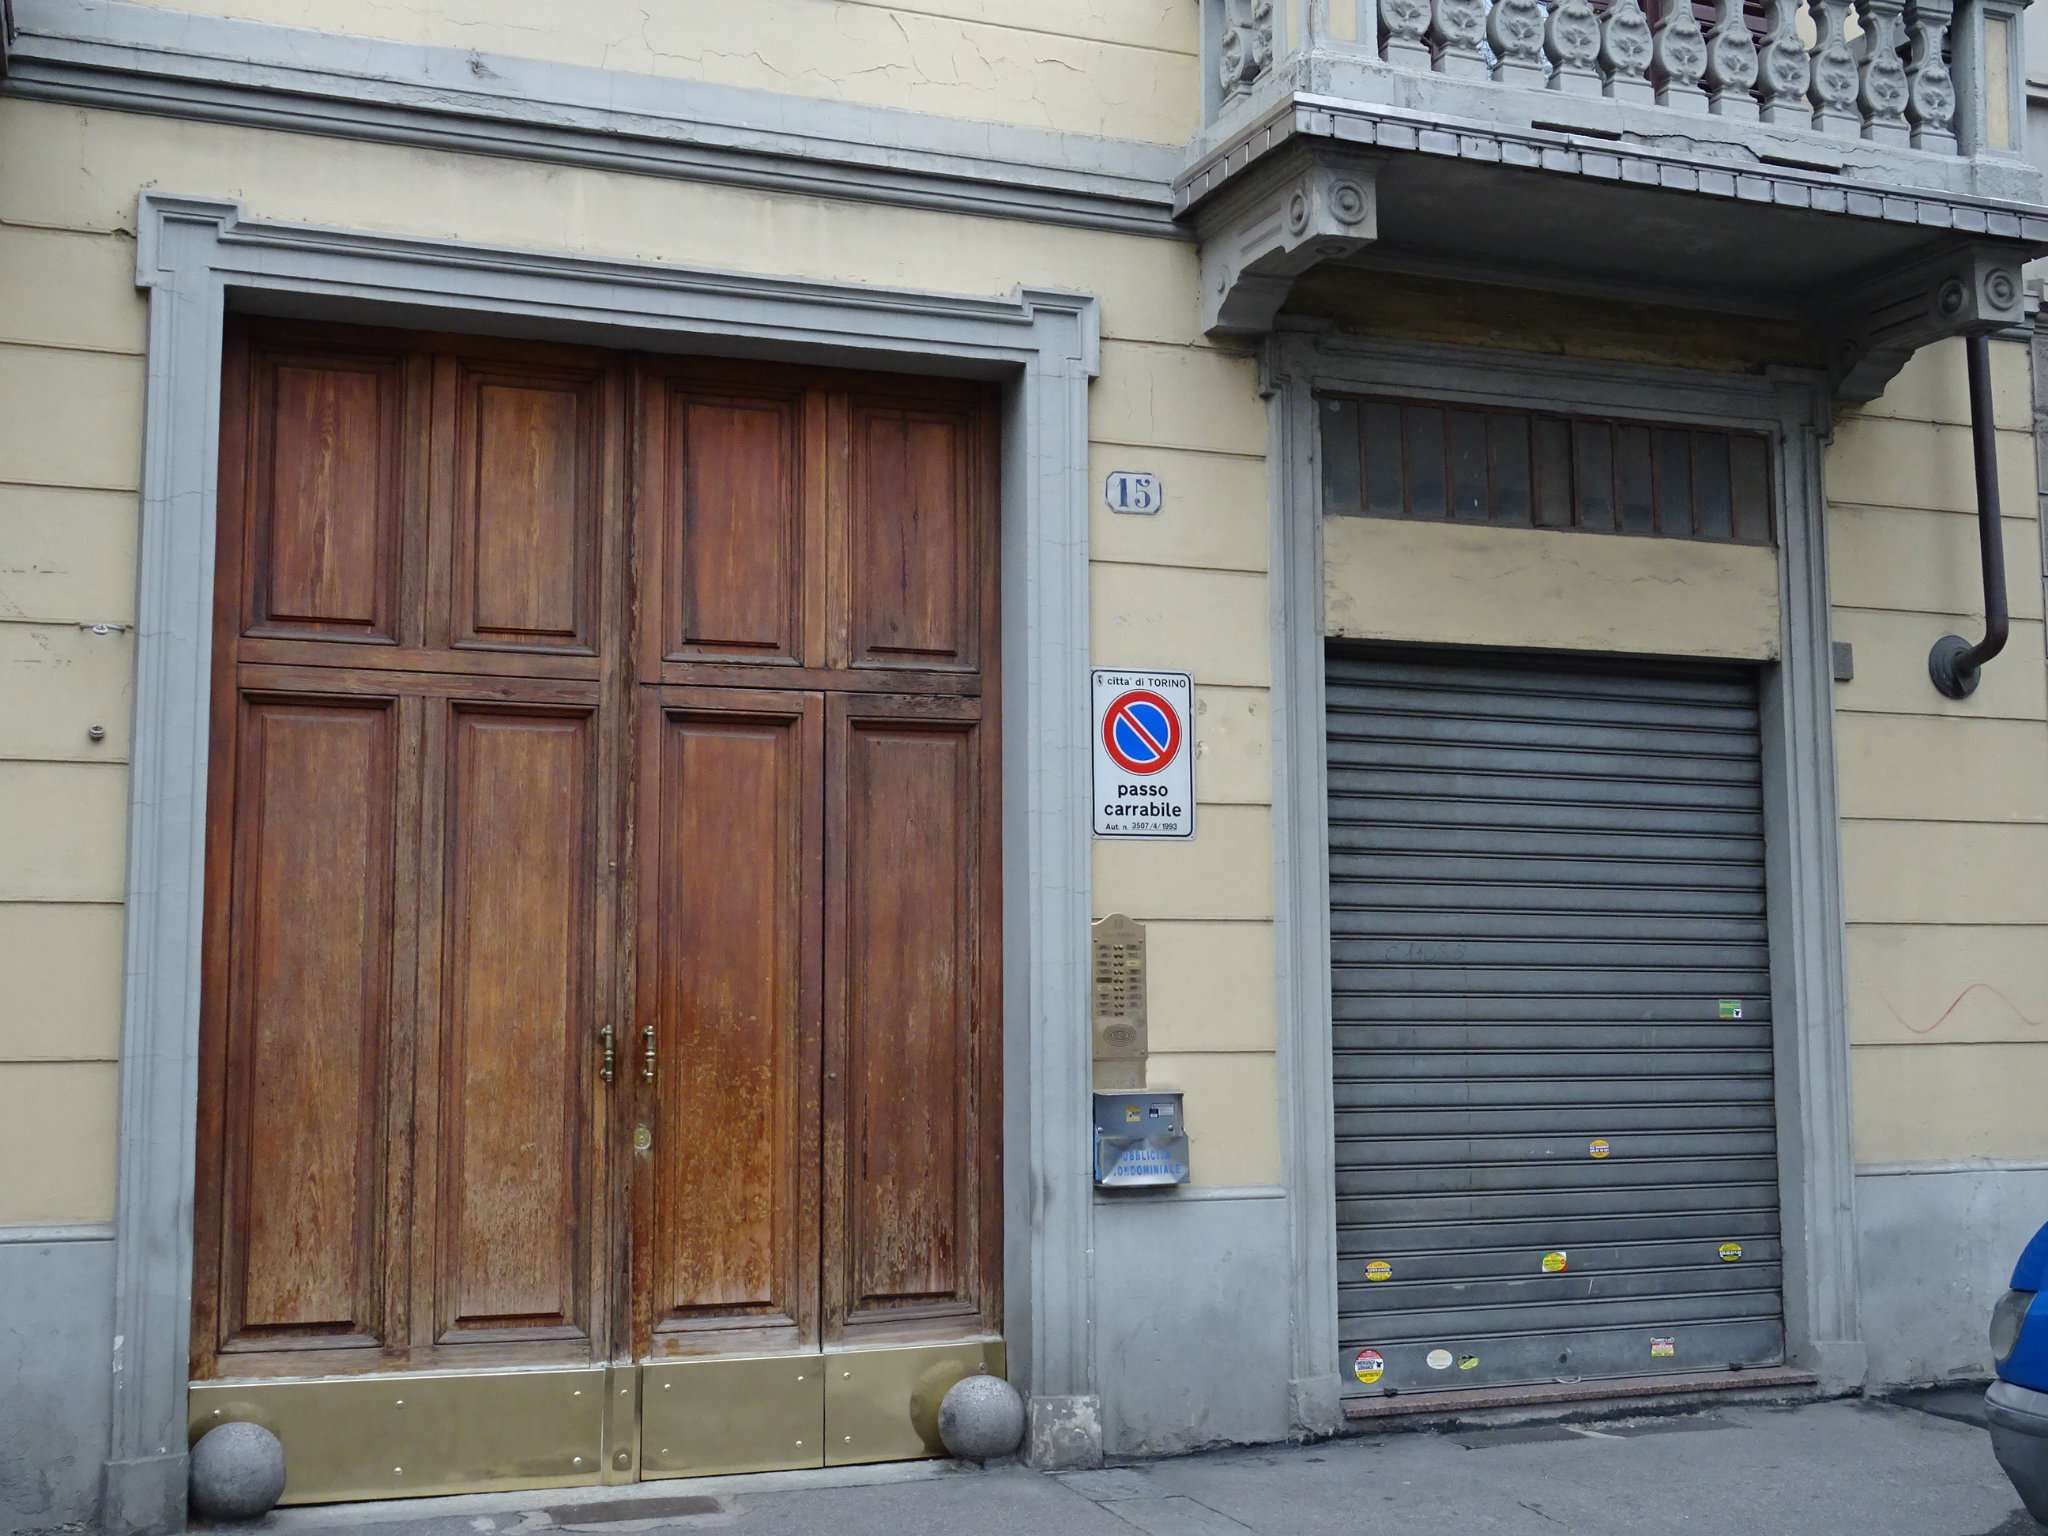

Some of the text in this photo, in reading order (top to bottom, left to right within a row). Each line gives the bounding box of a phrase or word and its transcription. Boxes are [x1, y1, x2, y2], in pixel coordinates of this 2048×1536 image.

[1119, 478, 1151, 509] 15
[1135, 678, 1144, 687] di
[1148, 678, 1186, 688] TORINO
[1118, 784, 1168, 799] passo
[1104, 801, 1182, 817] carrabile
